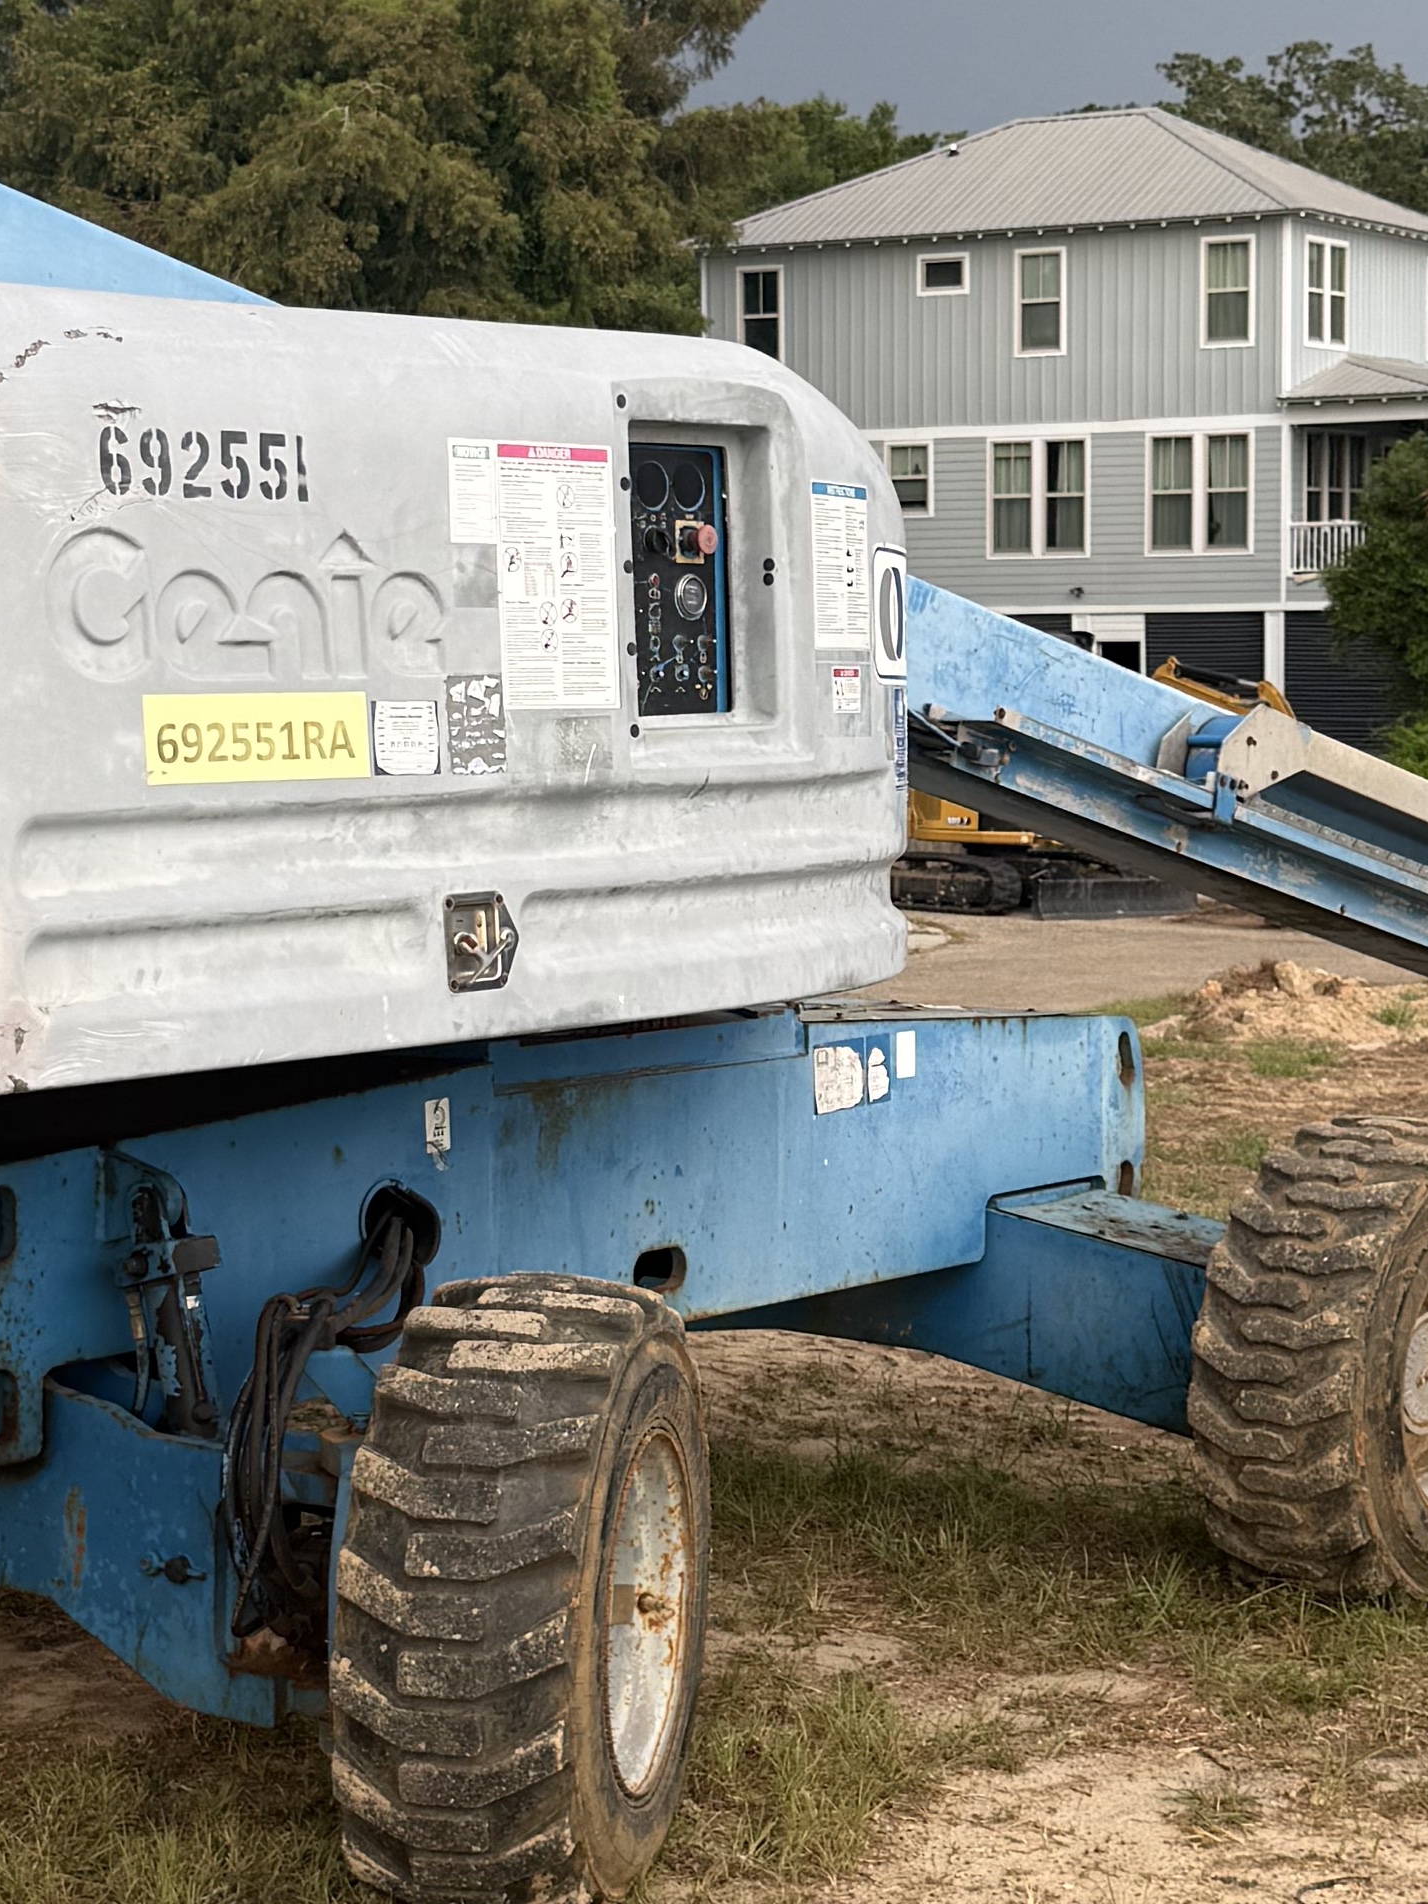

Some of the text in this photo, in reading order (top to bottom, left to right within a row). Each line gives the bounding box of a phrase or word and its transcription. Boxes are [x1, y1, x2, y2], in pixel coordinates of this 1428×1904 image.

[100, 426, 309, 502] 692551
[46, 527, 446, 683] Genie
[156, 720, 356, 764] 692551RA
